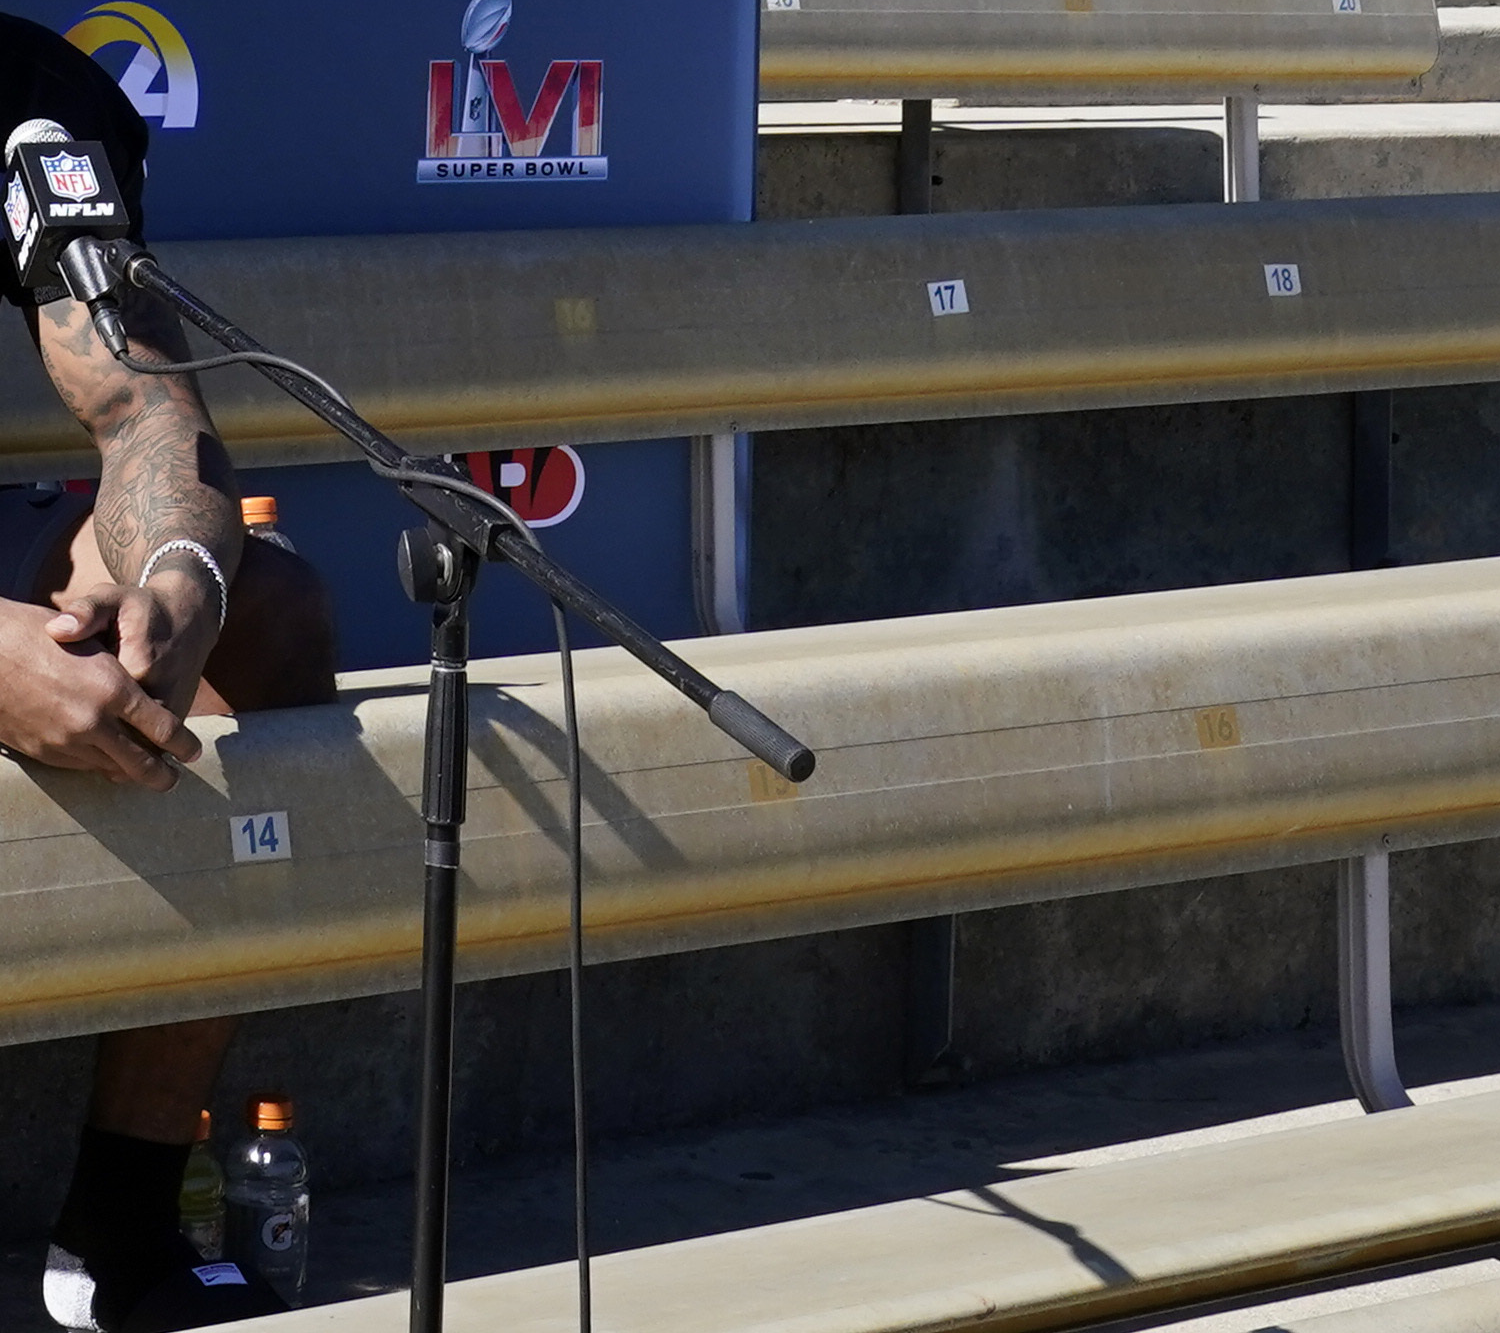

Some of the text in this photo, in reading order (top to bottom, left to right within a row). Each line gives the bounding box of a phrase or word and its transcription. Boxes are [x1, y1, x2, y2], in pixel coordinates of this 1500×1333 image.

[426, 60, 601, 158] LVI
[436, 160, 589, 177] SUPER BOWL
[53, 172, 93, 194] NFL
[49, 202, 115, 217] NFLN
[1272, 268, 1293, 291] 18
[935, 285, 955, 310] 17
[242, 817, 278, 854] 14
